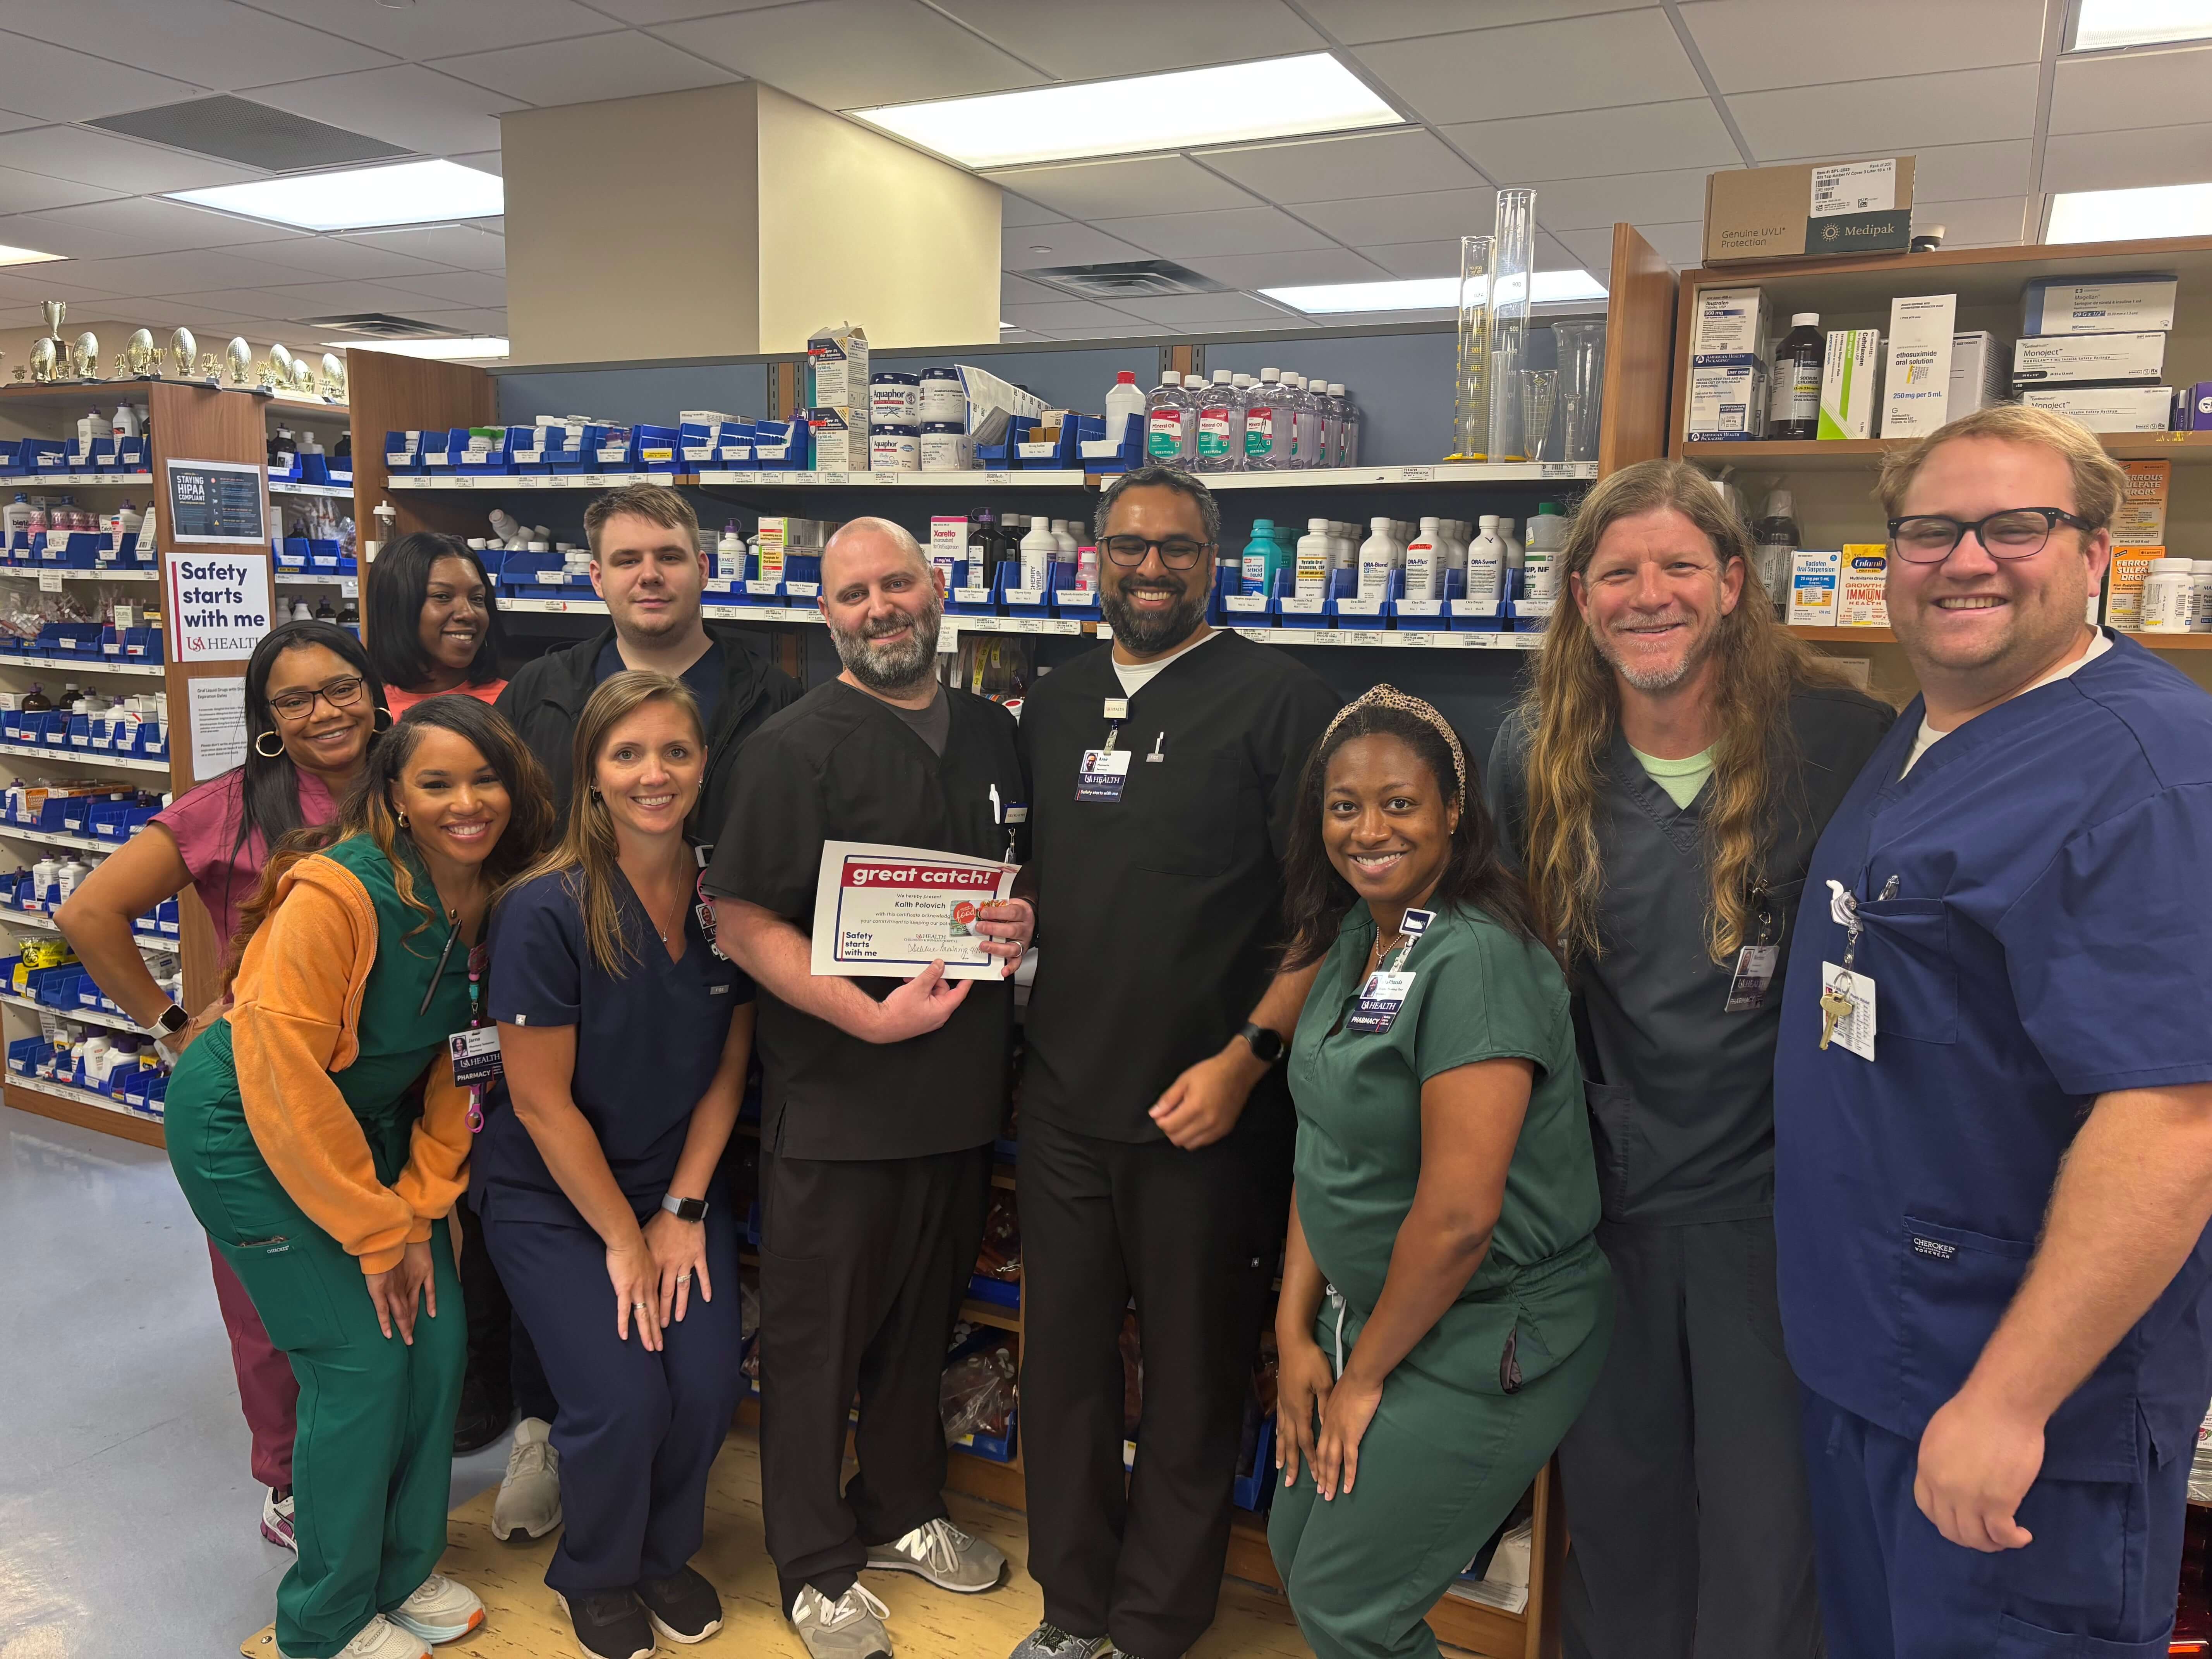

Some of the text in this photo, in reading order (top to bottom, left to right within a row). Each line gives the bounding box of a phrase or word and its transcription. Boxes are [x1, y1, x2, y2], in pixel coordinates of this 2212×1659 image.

[1722, 230, 1759, 239] Genuine
[1845, 223, 1895, 237] Medipak
[1721, 239, 1766, 248] Protection
[1859, 332, 1868, 366] Ceftriaxone
[1896, 350, 1937, 359] ethosuximide
[874, 389, 905, 400] Aquaphor
[874, 440, 898, 449] Aquaphor
[177, 475, 204, 484] STAYING
[177, 484, 205, 495] HIPAA
[181, 561, 247, 586] Safety
[183, 587, 243, 604] starts
[184, 609, 265, 627] with me
[186, 636, 206, 652] USA
[853, 867, 991, 885] great catch!
[955, 908, 975, 924] food
[846, 931, 873, 941] Safety
[1370, 1001, 1396, 1010] HEALTH
[1351, 1016, 1380, 1025] PHARMACY
[471, 1053, 500, 1065] HEALTH
[457, 1070, 491, 1082] PHARMACY
[1915, 1247, 1950, 1259] WORKWEAR
